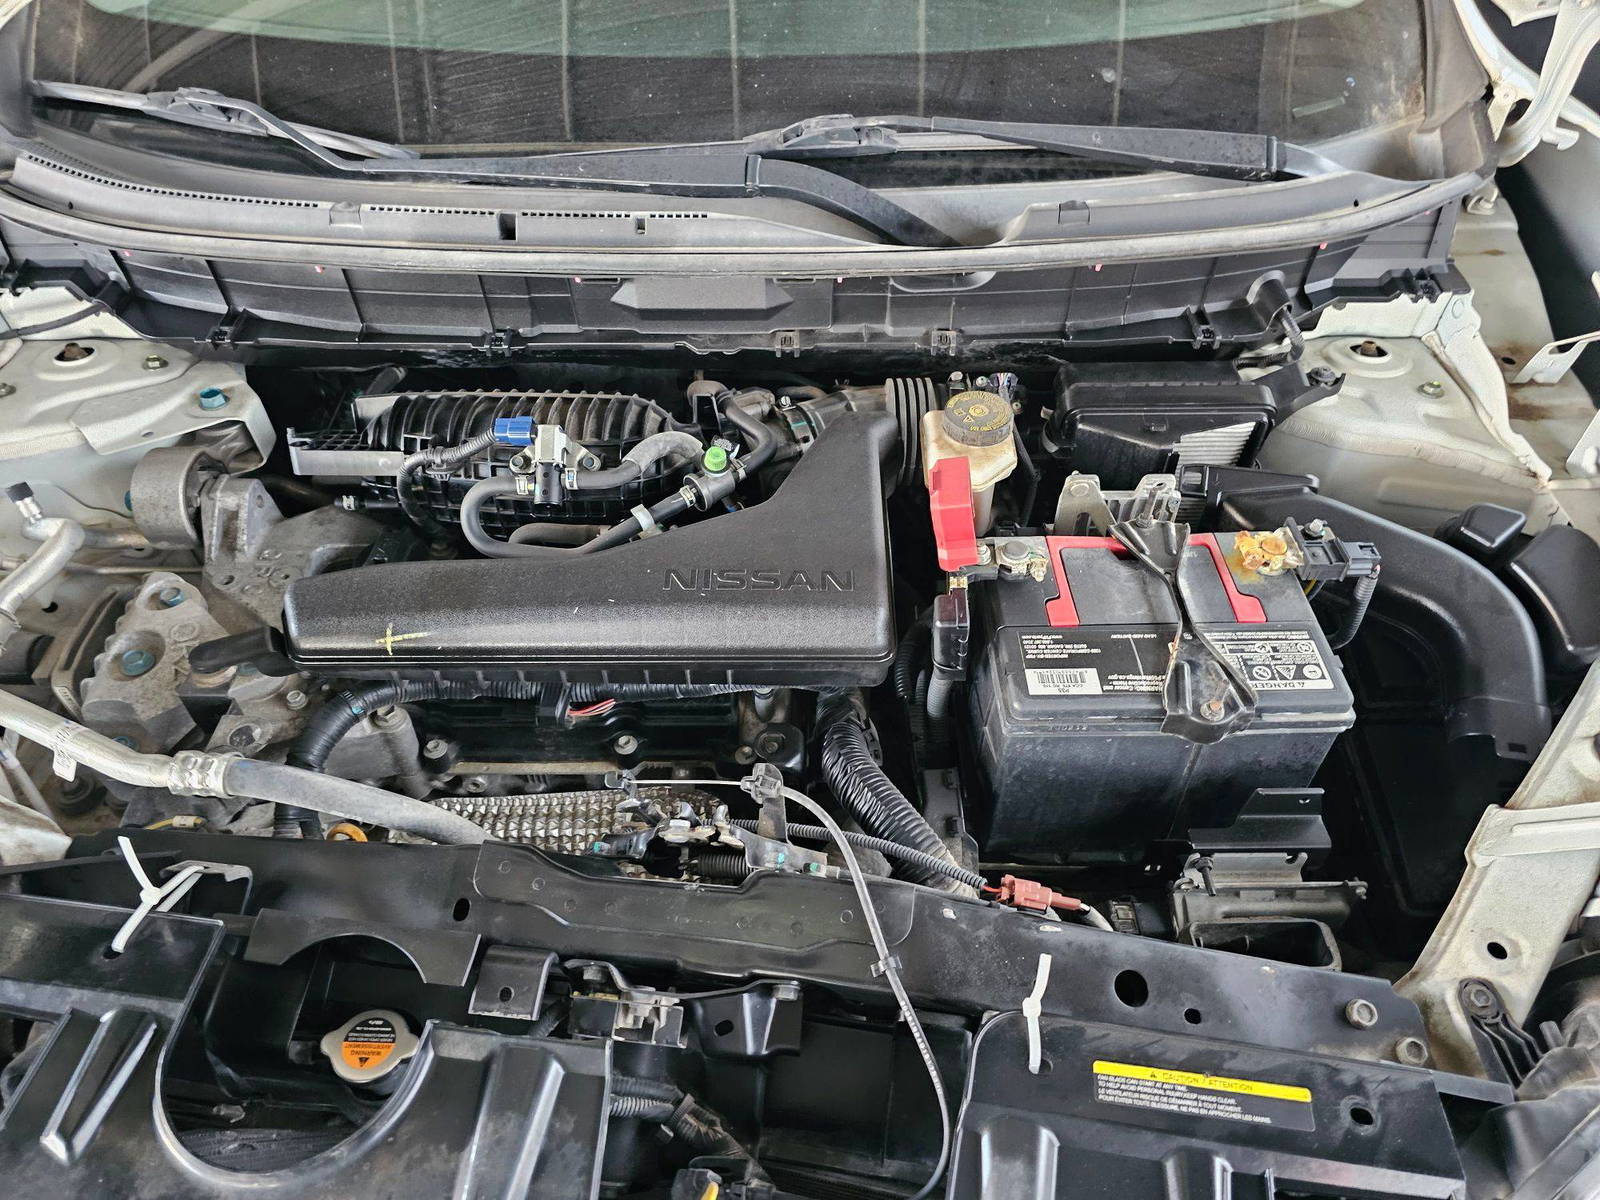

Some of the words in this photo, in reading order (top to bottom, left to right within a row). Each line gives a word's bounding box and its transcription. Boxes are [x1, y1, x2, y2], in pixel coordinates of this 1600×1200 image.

[662, 568, 854, 591] NISSAN
[1162, 1072, 1199, 1084] CAUTION
[1208, 1078, 1253, 1092] ATTENTION
